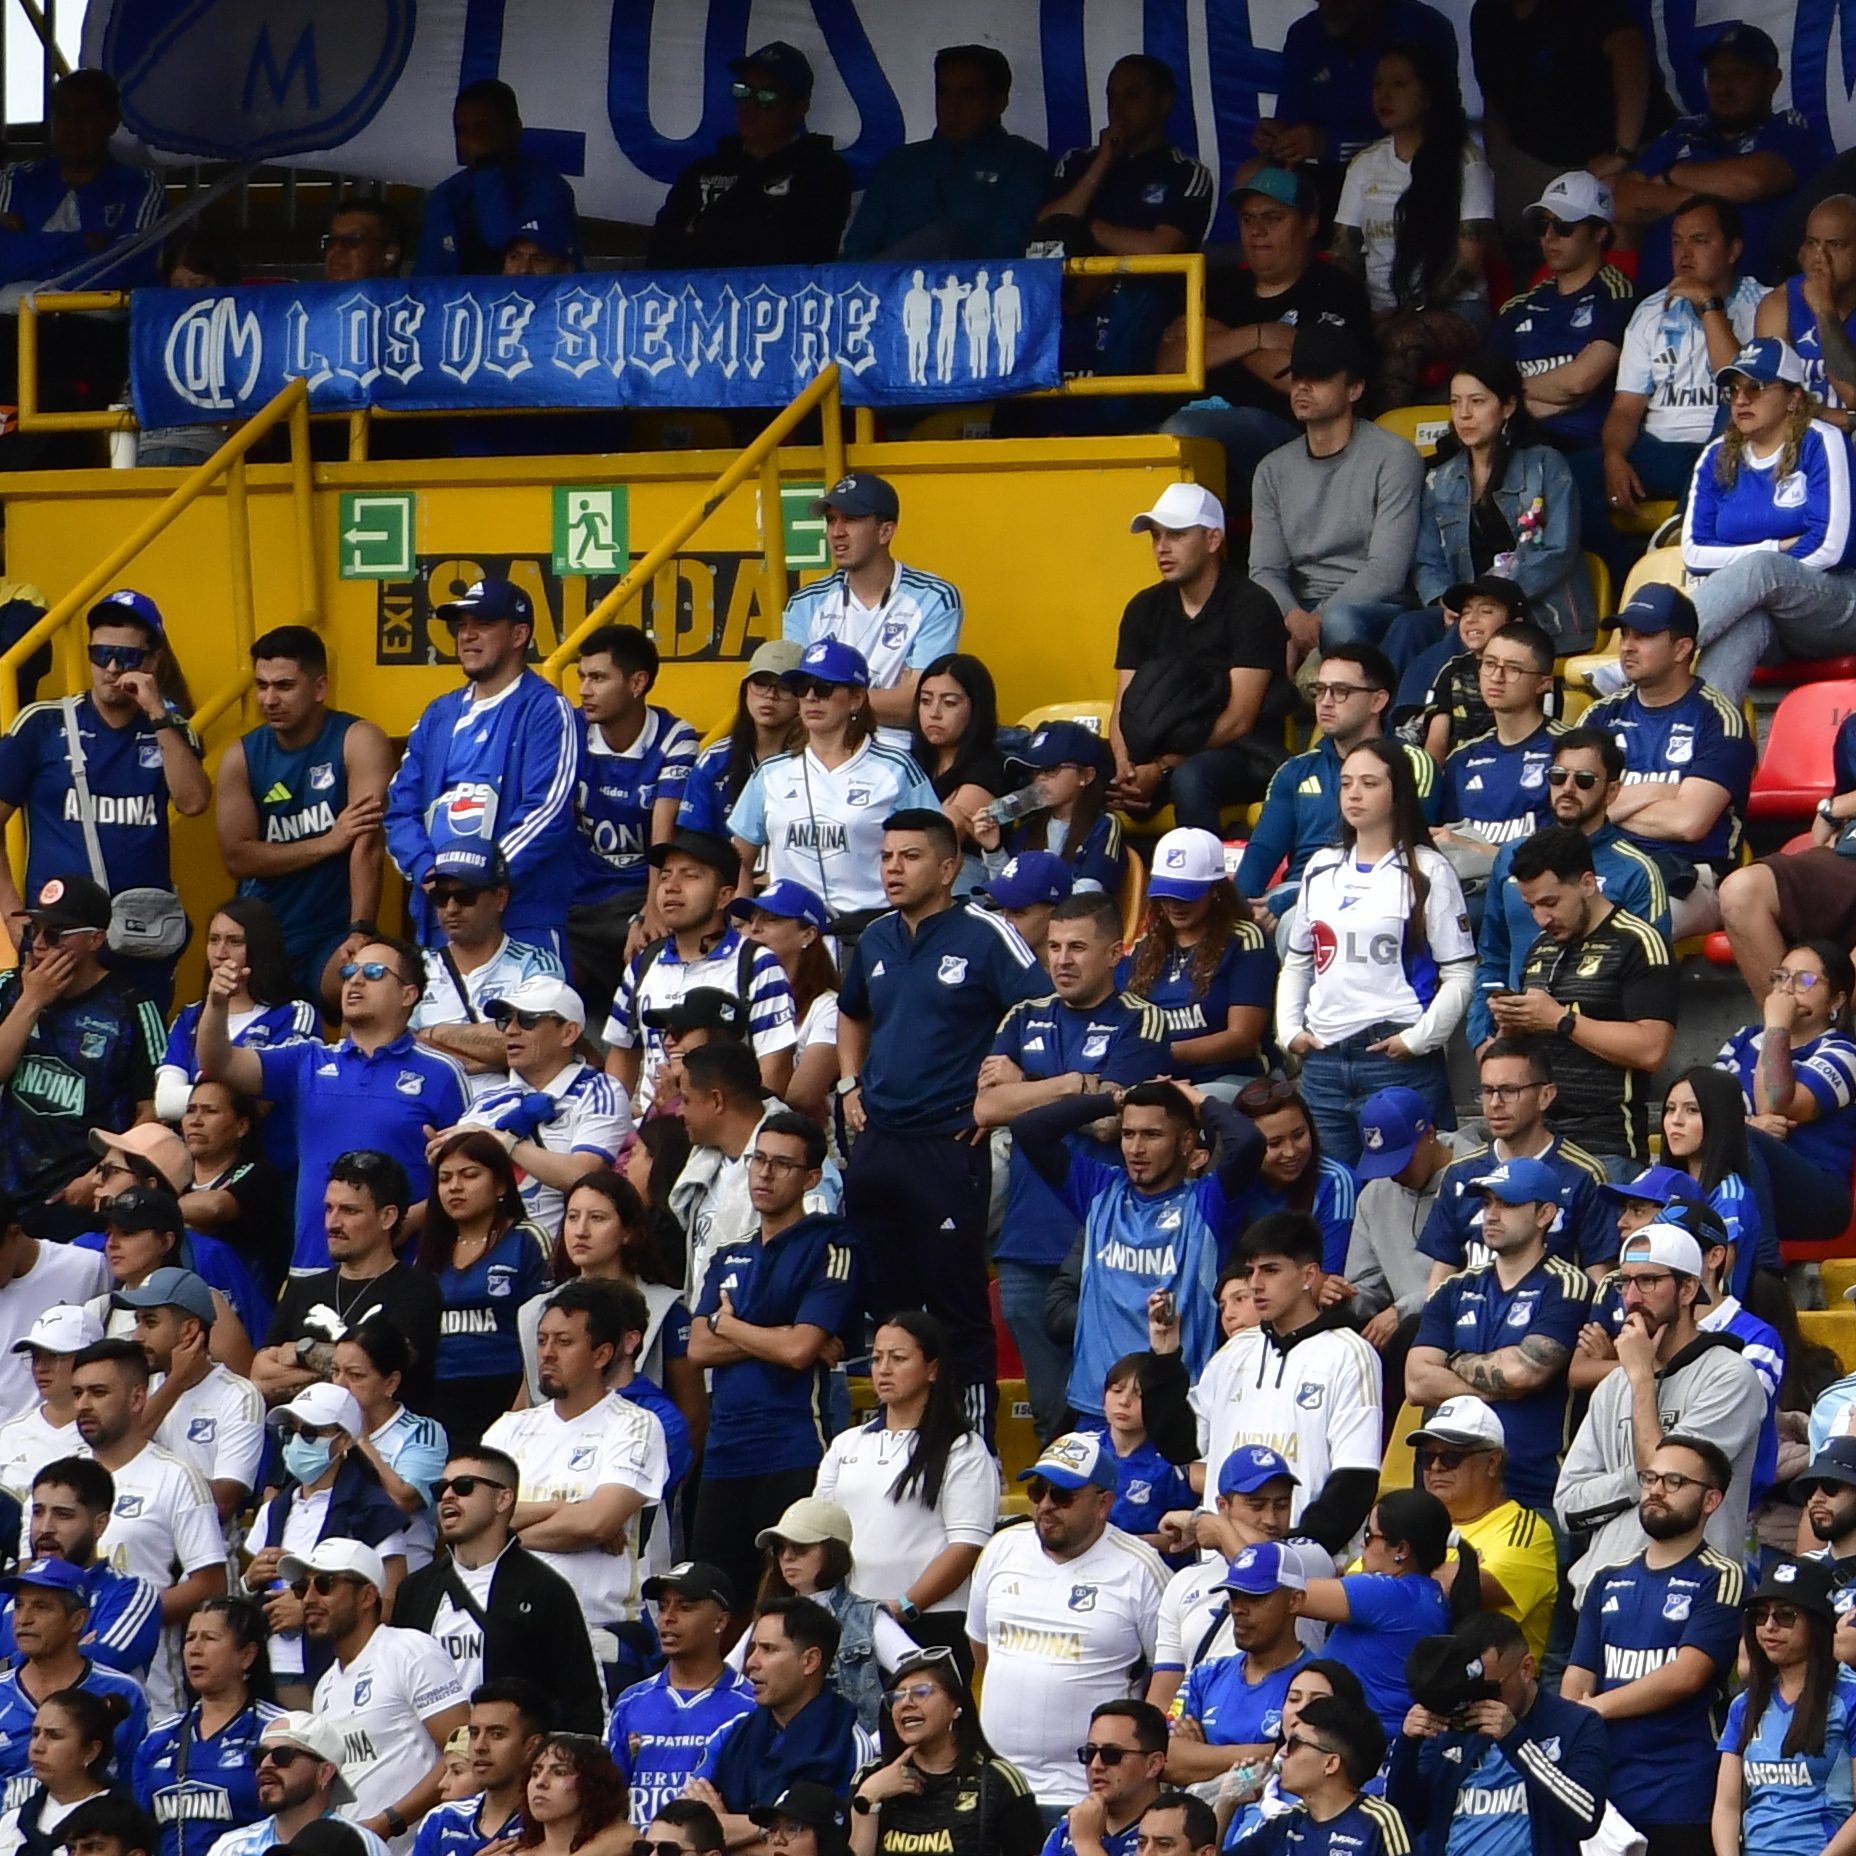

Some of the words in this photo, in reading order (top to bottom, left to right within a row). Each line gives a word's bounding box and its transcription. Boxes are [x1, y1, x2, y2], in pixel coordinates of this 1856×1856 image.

[284, 291, 425, 393] LOS
[440, 288, 535, 384] DE
[552, 280, 882, 381] SIEMPRE
[382, 578, 415, 656] EXIT
[67, 791, 159, 827] ADINA
[1474, 811, 1536, 844] NDINA
[1351, 927, 1400, 958] LG
[1813, 1056, 1842, 1090] LEONA
[1097, 1240, 1178, 1276] ANDINA
[997, 1629, 1082, 1663] ANDINA
[1744, 1759, 1812, 1787] ANDINA
[883, 1827, 956, 1854] ANDINA
